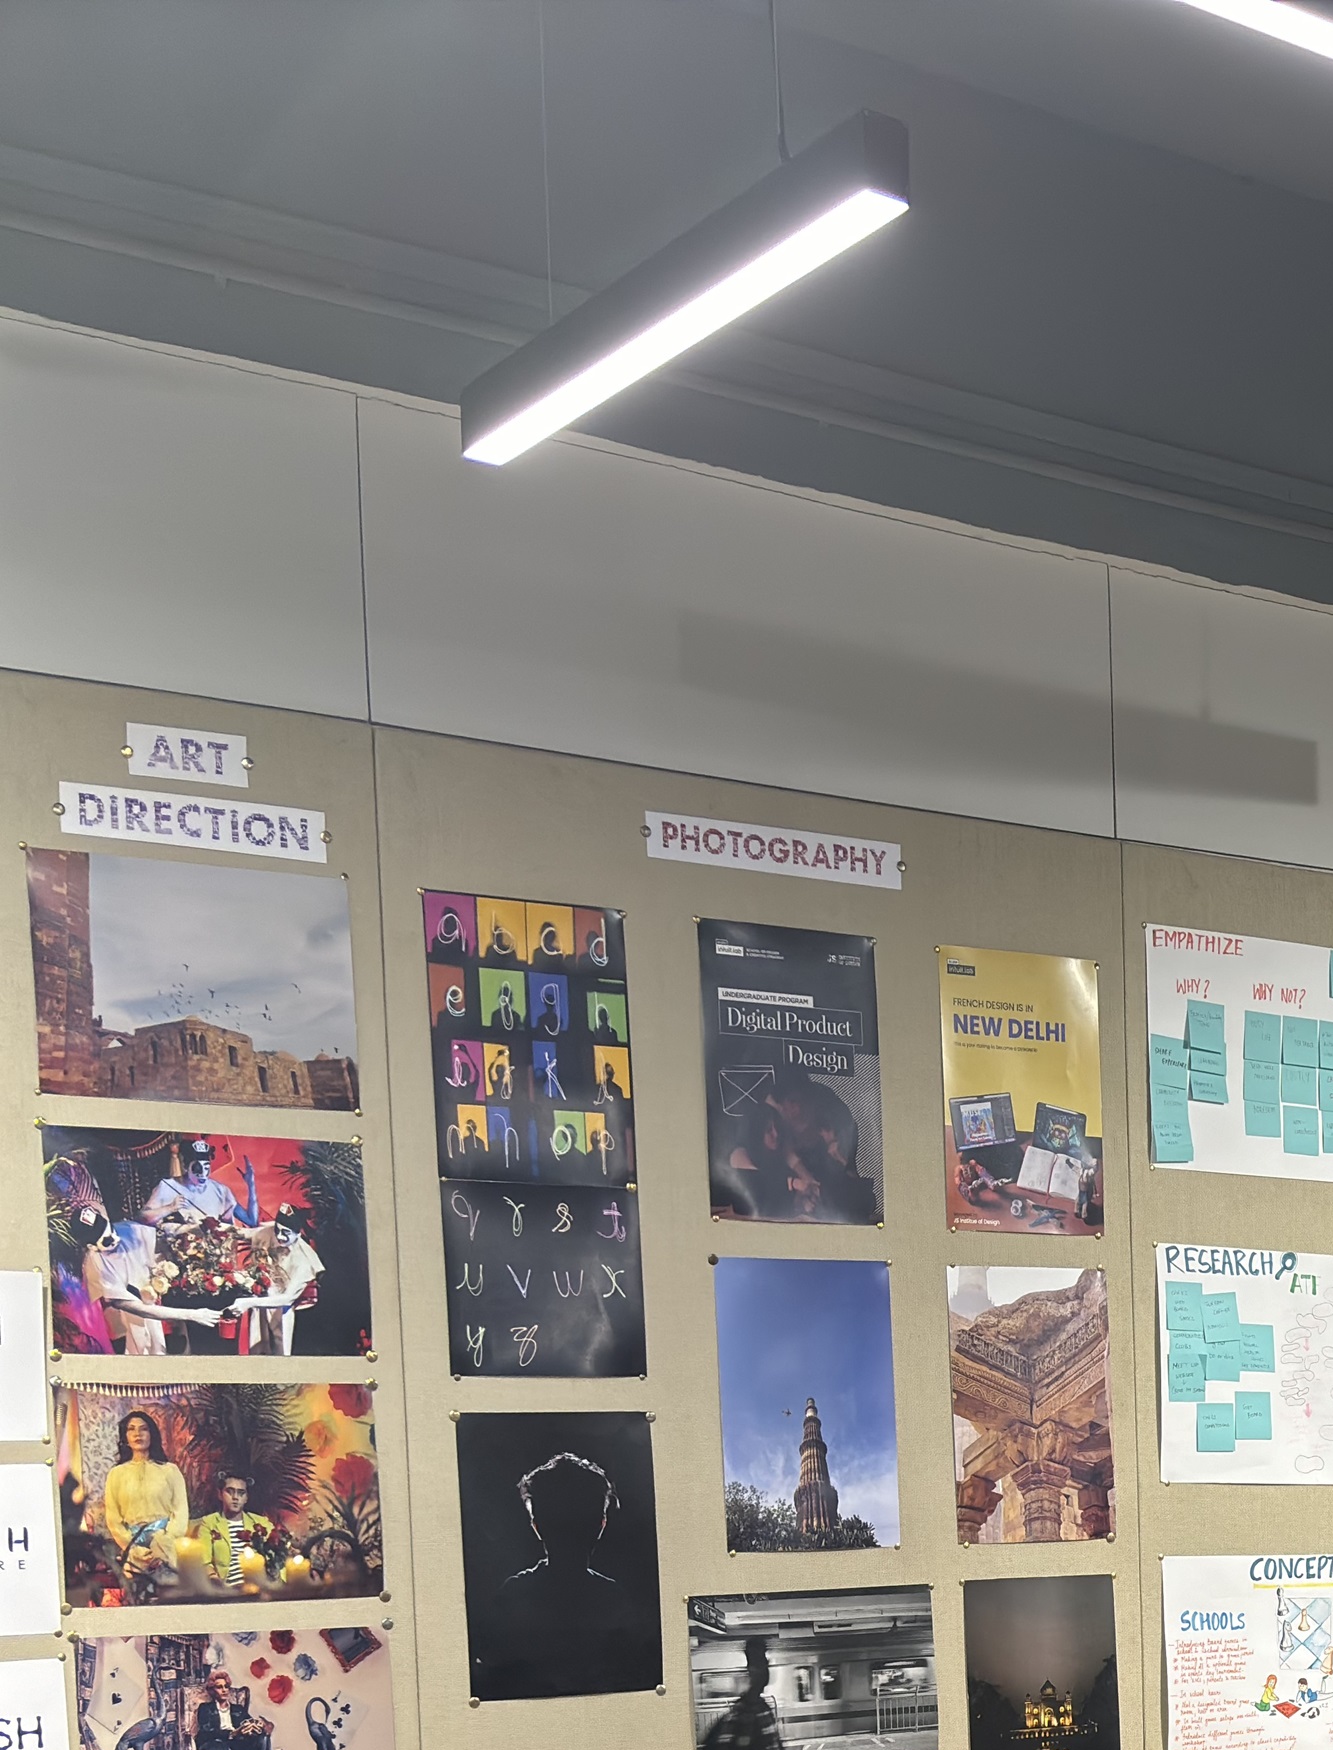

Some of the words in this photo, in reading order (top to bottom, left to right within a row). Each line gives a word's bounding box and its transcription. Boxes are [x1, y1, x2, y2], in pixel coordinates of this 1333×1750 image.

[147, 735, 229, 775] ART
[78, 792, 310, 851] DIRECTION
[661, 821, 887, 876] PHOTOGRAPHY
[1153, 928, 1244, 957] EMPATHIZE
[722, 990, 777, 1003] UNDERGRADUATE
[778, 995, 809, 1005] PROGRAM
[953, 997, 985, 1009] FRENCH
[986, 1000, 1015, 1011] DESIGN
[1016, 1003, 1023, 1012] IS
[1025, 1004, 1034, 1013] IN
[1253, 983, 1274, 1001] WHY
[1281, 988, 1306, 1009] NOT?
[727, 1006, 782, 1033] Digital
[785, 1011, 853, 1037] Product
[953, 1013, 1003, 1037] NEW
[1008, 1018, 1066, 1043] DELHI
[788, 1044, 848, 1073] Design
[1165, 1245, 1273, 1277] RESEARCH
[1181, 1609, 1246, 1632] SCHOOLS
